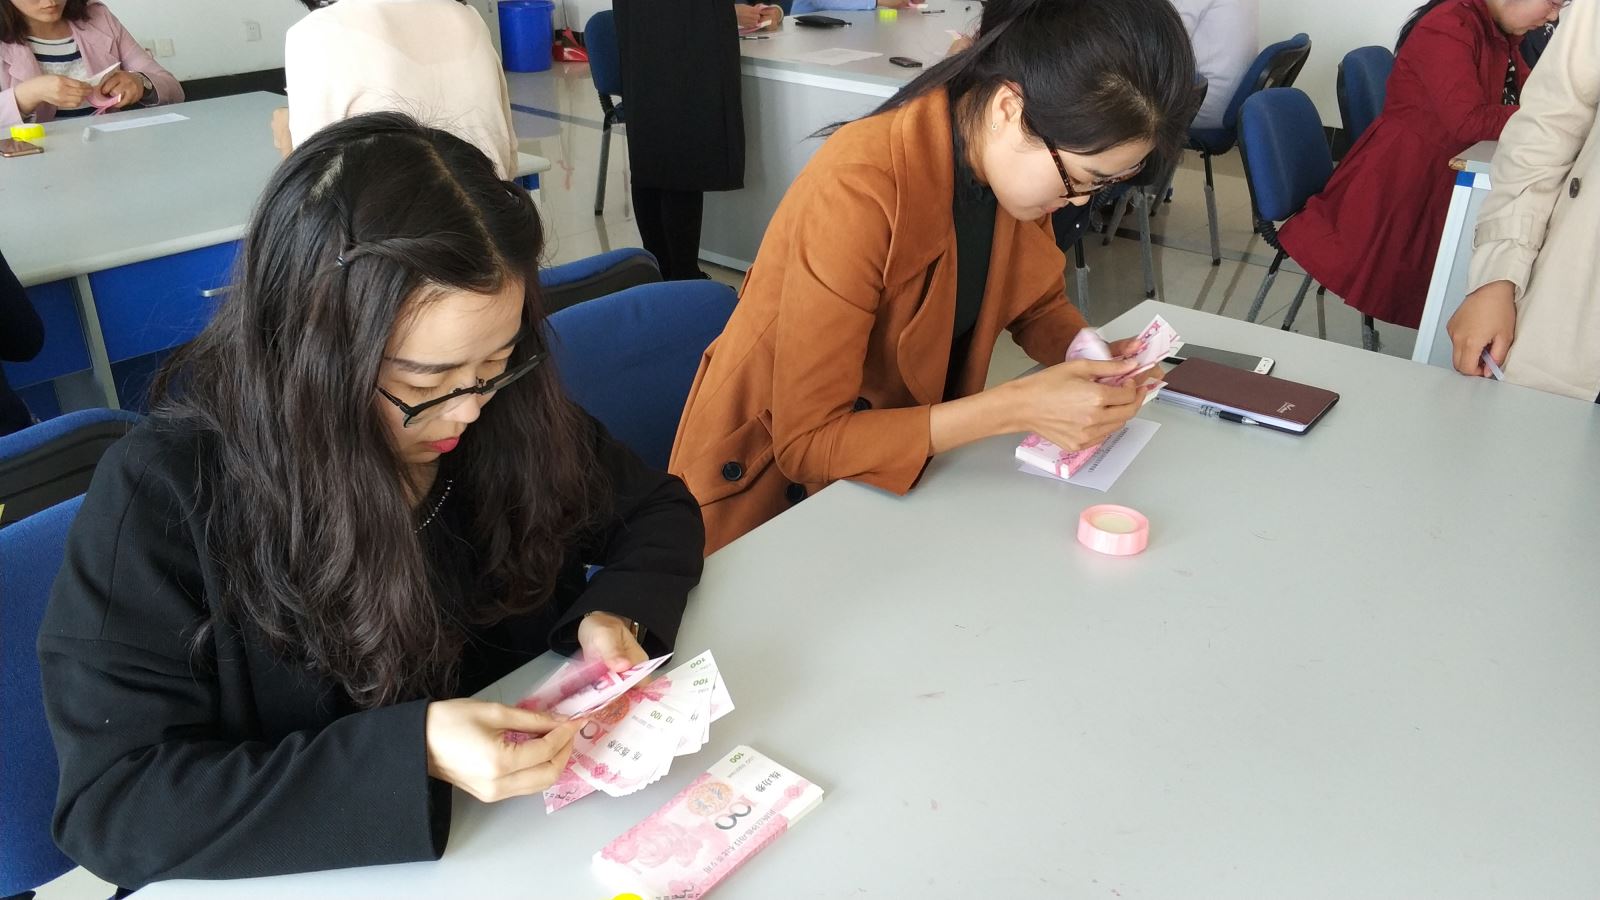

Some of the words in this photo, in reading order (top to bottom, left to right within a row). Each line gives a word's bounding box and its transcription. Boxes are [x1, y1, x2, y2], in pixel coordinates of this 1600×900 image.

[690, 656, 706, 669] 100
[693, 678, 709, 688] 100
[650, 709, 662, 721] 100
[665, 715, 674, 724] 10
[729, 751, 745, 764] 100
[755, 770, 781, 793] 练功券
